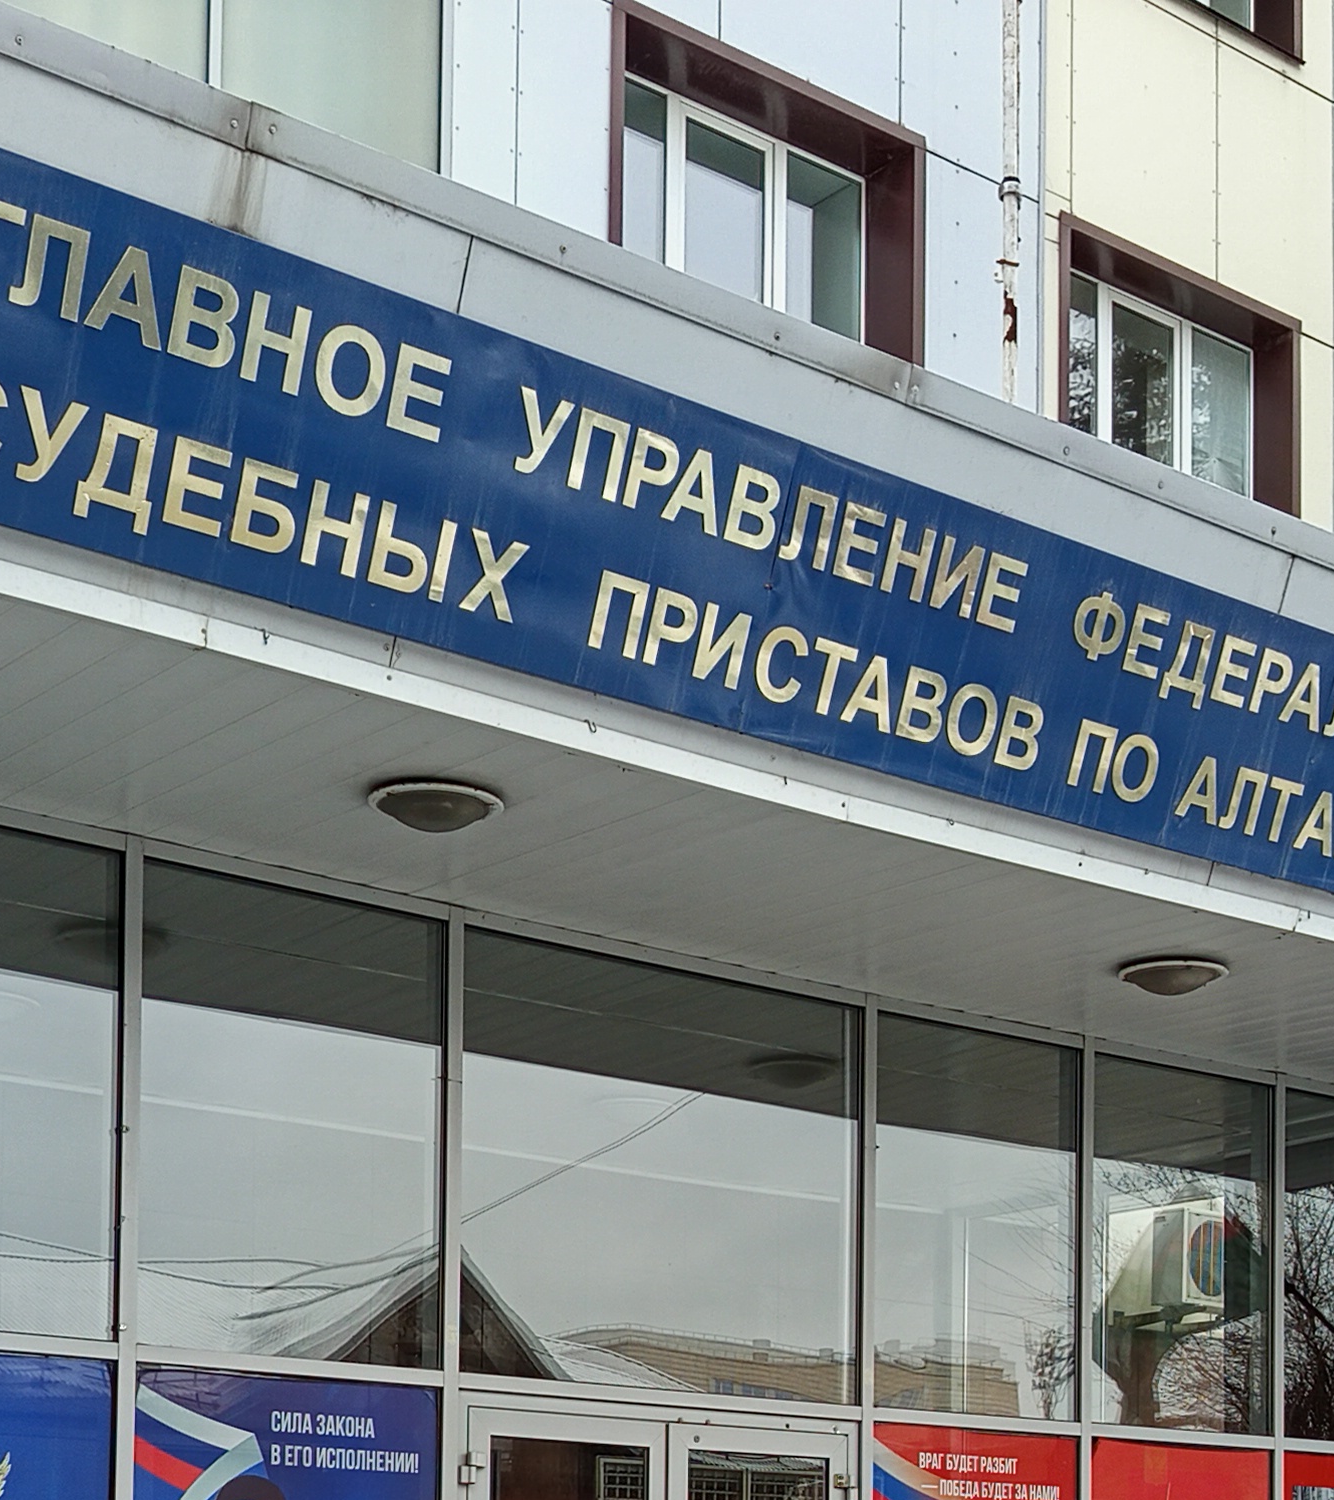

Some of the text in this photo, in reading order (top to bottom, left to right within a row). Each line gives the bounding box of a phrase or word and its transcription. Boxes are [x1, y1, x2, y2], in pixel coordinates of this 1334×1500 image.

[514, 386, 1029, 634] УПРАВЛЕНИЕ
[588, 570, 1044, 771] ПРИСТАВОВ
[1067, 718, 1160, 802] ПО
[271, 1410, 375, 1439] СИЛА ЗАКОНА
[271, 1444, 419, 1474] В ЕГО ИСПОЛНЕНИИ!
[919, 1452, 1018, 1475] ВРАГ БУДЕТ РАЗБИТ
[939, 1479, 980, 1499] ПОБЕДА
[981, 1482, 1014, 1500] БУДЕТ
[1015, 1484, 1028, 1500] ЗА
